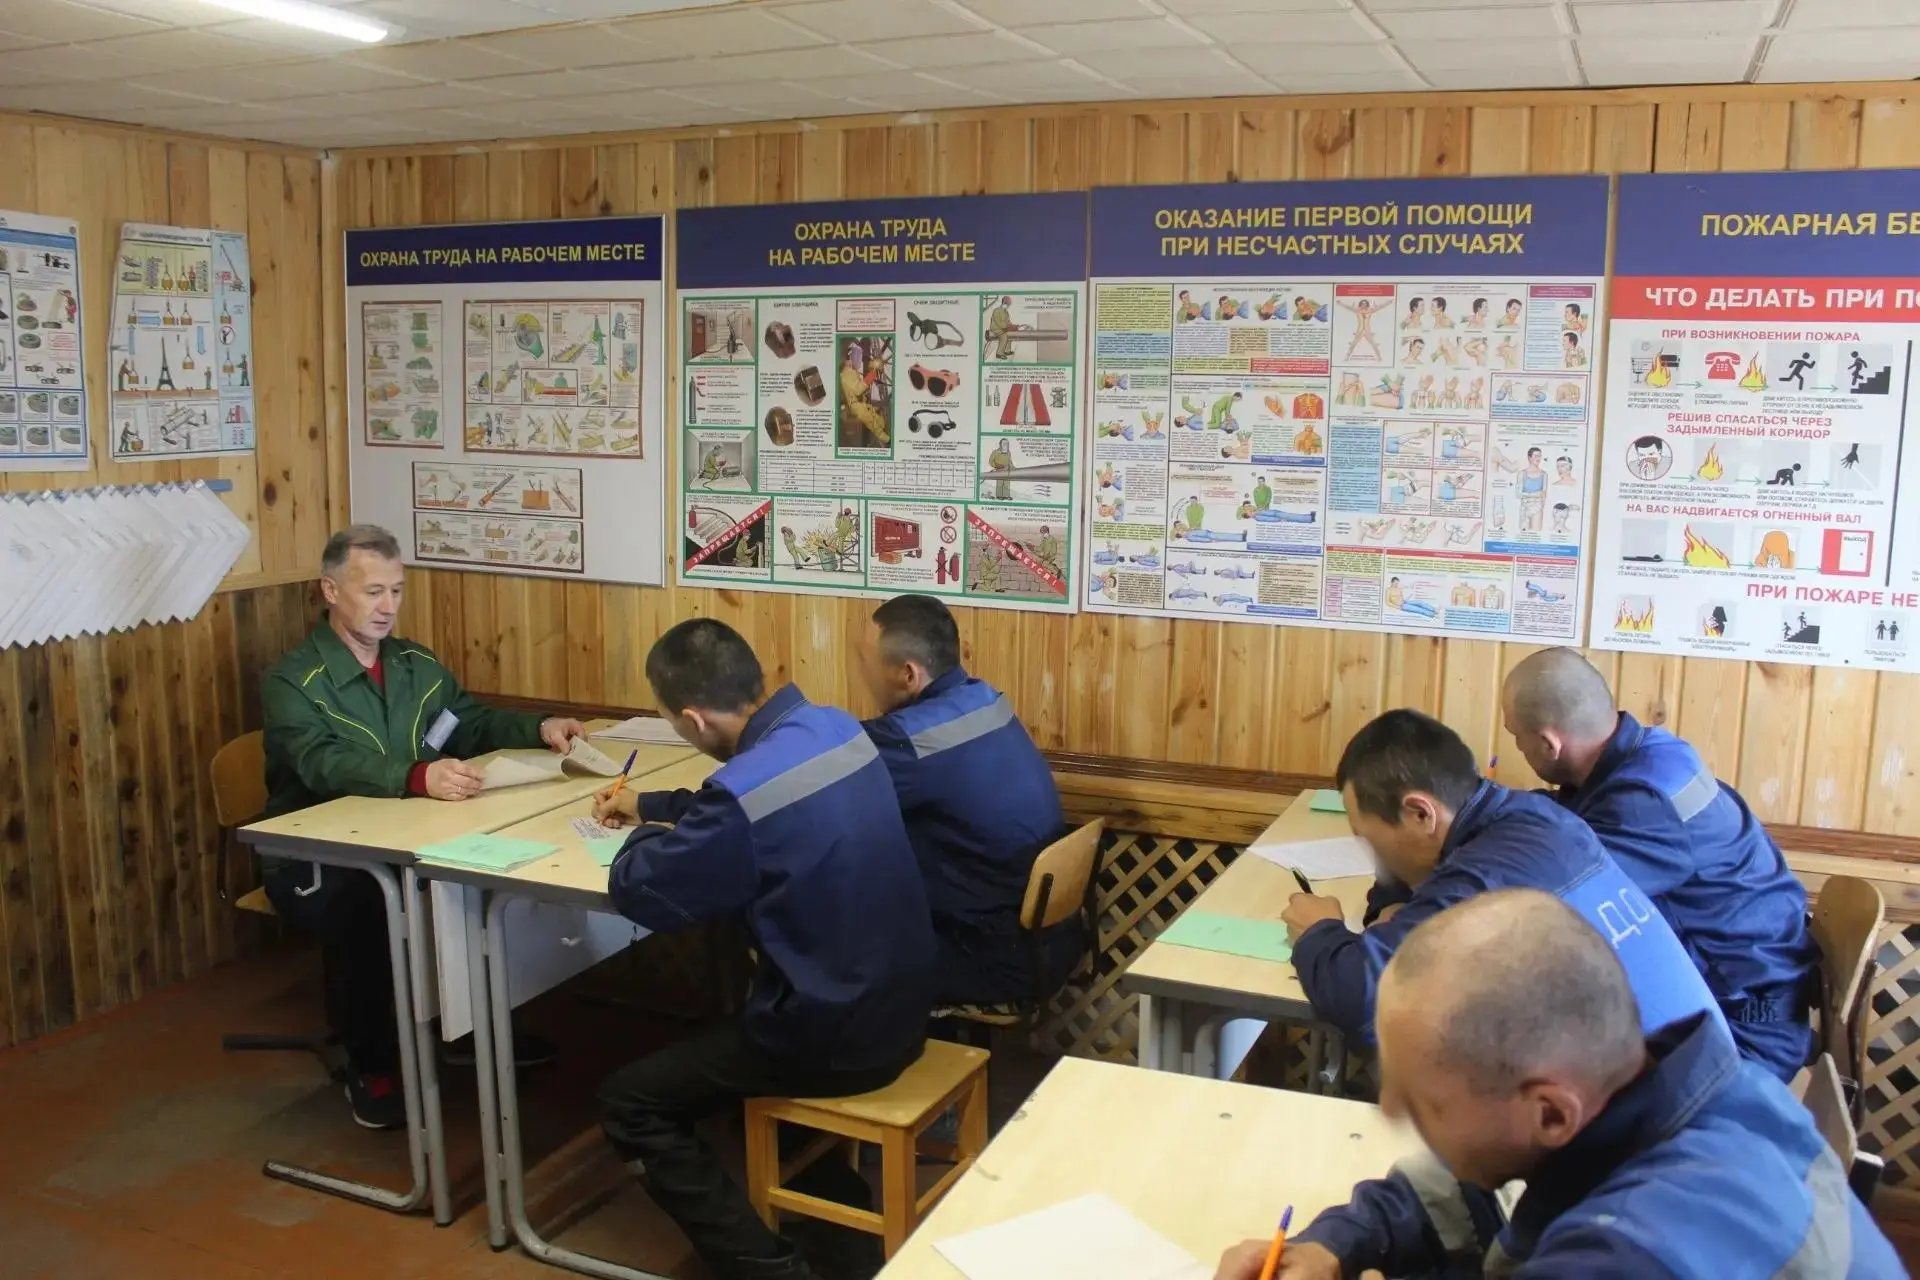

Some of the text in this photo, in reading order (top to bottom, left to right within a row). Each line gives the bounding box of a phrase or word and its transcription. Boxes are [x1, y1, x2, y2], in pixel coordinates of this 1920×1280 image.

[794, 216, 948, 241] ОХРАНА ТРУДА
[1154, 203, 1534, 230] ОКАЗАНИЕ ПЕРВОЙ ПОМОЩИ
[1701, 212, 1878, 237] ПОЖАРНАЯ
[360, 243, 646, 268] ОХРАНА ТРУДА НА РАБОЧЕМ МЕСТЕ
[768, 242, 976, 267] НА РАБОЧЕМ МЕСТЕ
[1161, 232, 1525, 257] ПРИ НЕСЧАСТНЫХ СЛУЧАЯХ
[1645, 287, 1920, 311] ЧТО ДЕЛАТЬ ПРИ П
[1662, 329, 1860, 341] ПРИ ВОЗНИКНОВЕНИИ ПОЖАРА
[1667, 413, 1832, 426] РЕШИВ СПАСАТЬСЯ ЧЕРЕЗ
[1667, 424, 1831, 439] ЗАДЫМЛЕННЫЙ КОРИДОР
[1626, 504, 1861, 524] НА ВАС НАДВИГАЕТСЯ ОГНЕННЫЙ ВАЛ
[1747, 583, 1918, 607] ПРИ ПОЖАРЕ НЕ
